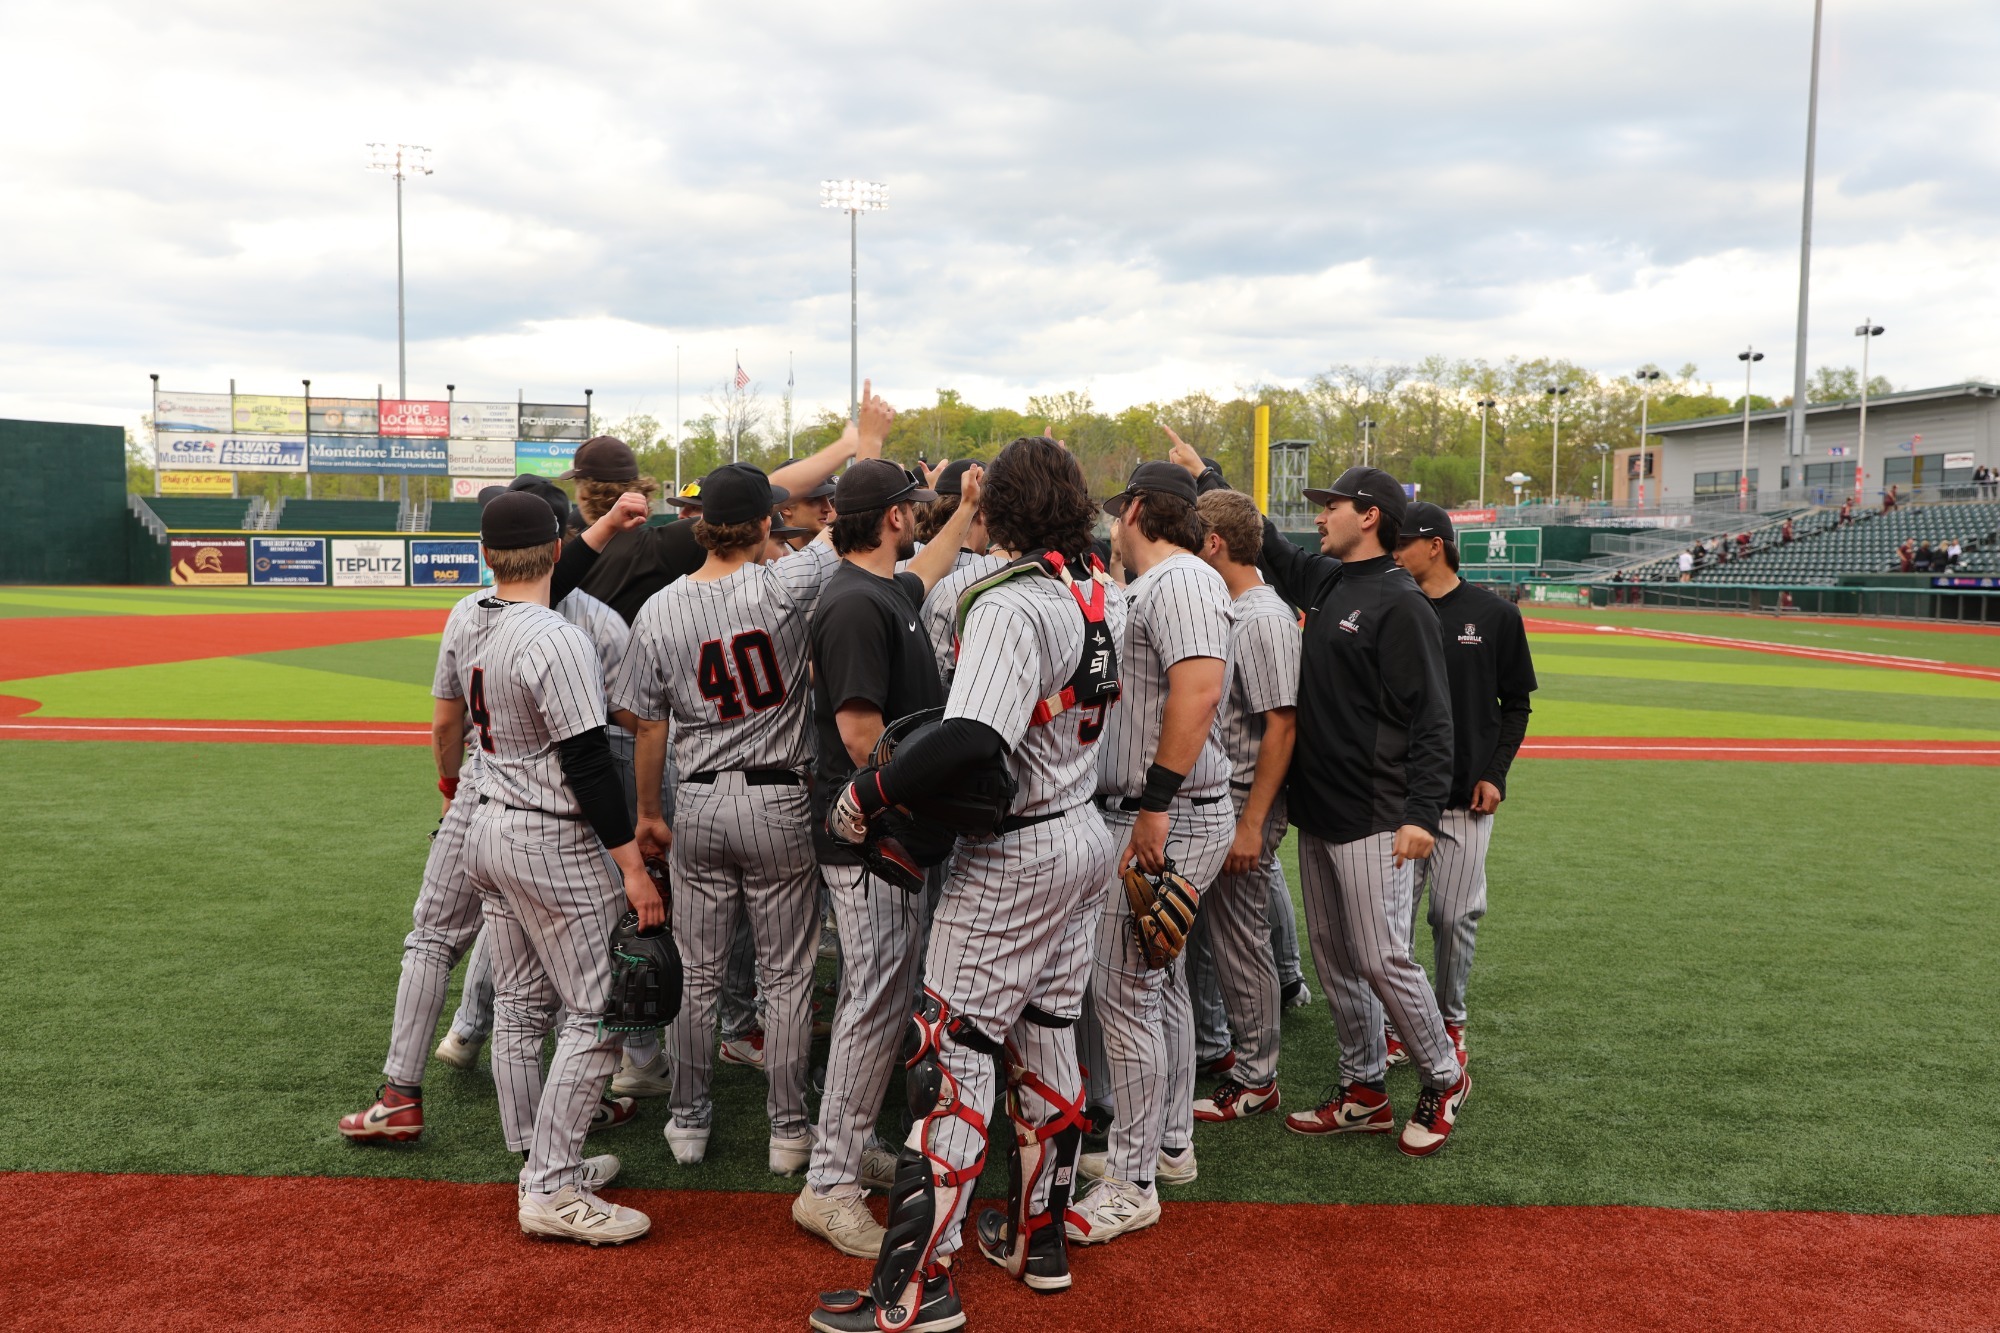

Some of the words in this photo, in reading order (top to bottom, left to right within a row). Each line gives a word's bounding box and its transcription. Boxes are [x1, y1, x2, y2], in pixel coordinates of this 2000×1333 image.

[398, 404, 430, 415] IUOE
[381, 415, 423, 425] LOCAL
[424, 416, 448, 426] 825
[520, 416, 586, 427] POWERADE
[224, 441, 281, 453] ALWAYS
[309, 443, 387, 459] Montefiore
[390, 445, 446, 460] Einstein
[159, 452, 216, 464] Members:
[222, 453, 299, 465] ESSENTIAL
[479, 455, 515, 465] Associates
[171, 540, 196, 548] Making
[336, 557, 402, 572] TEPLITZ
[413, 554, 429, 564] GO
[430, 554, 478, 564] FURTHER.
[433, 569, 459, 579] PACE
[699, 628, 787, 722] 40
[470, 667, 496, 754] 4
